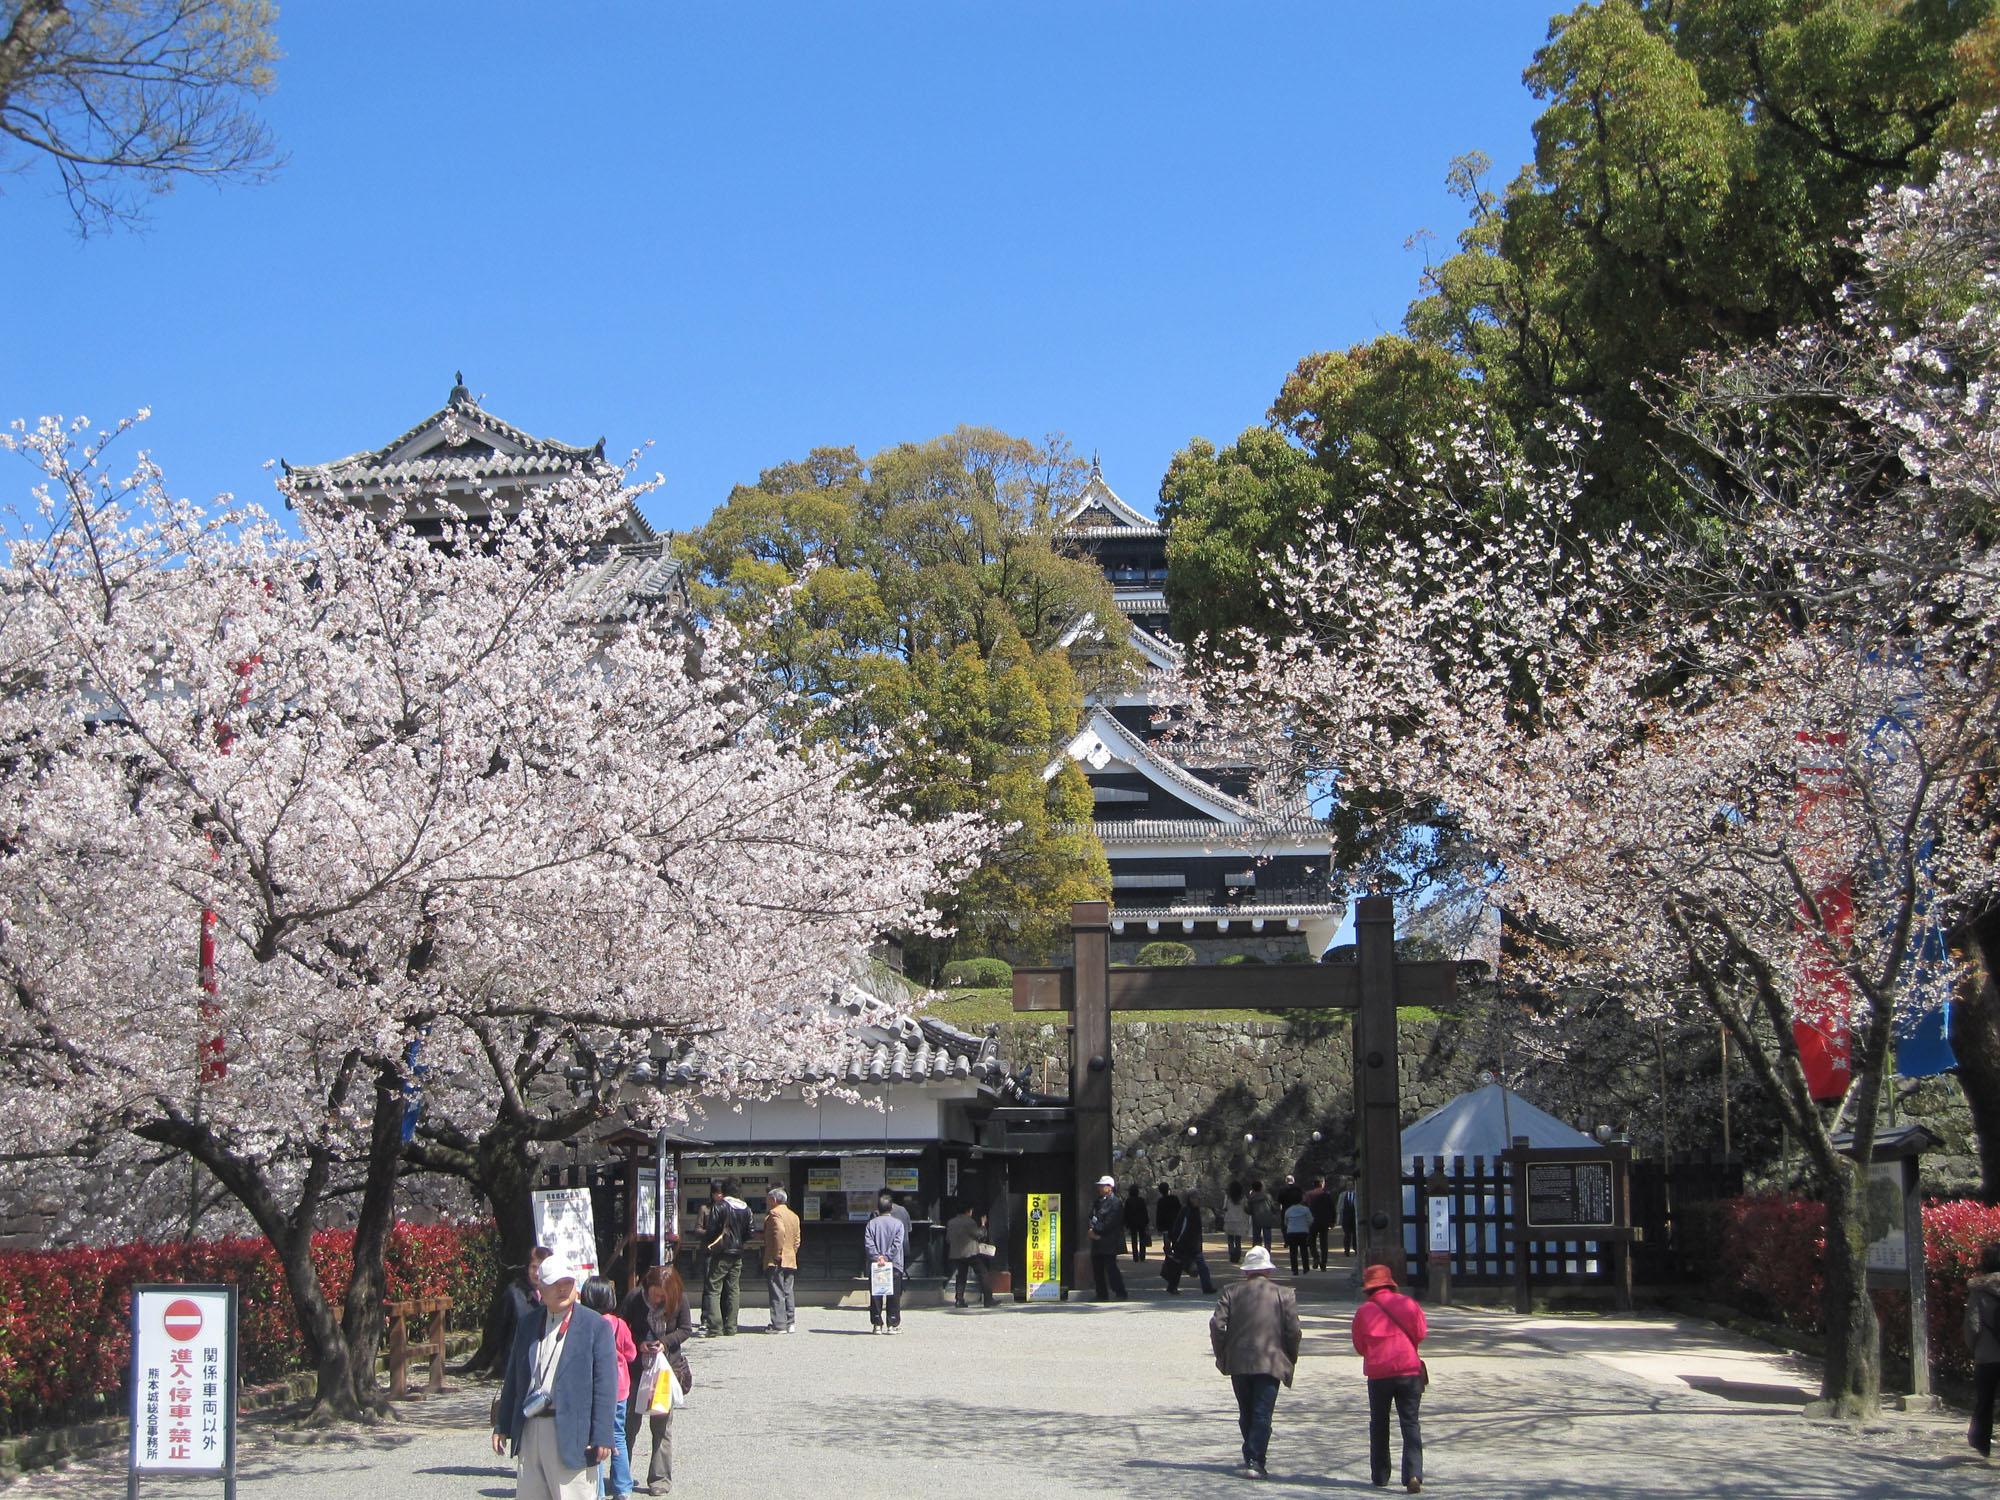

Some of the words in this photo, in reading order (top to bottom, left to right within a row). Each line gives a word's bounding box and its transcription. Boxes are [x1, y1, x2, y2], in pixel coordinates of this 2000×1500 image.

[146, 1368, 160, 1460] 熊本城総合事務所
[168, 1348, 193, 1460] 進入・停車・禁止
[202, 1347, 218, 1451] 関係車両以外
